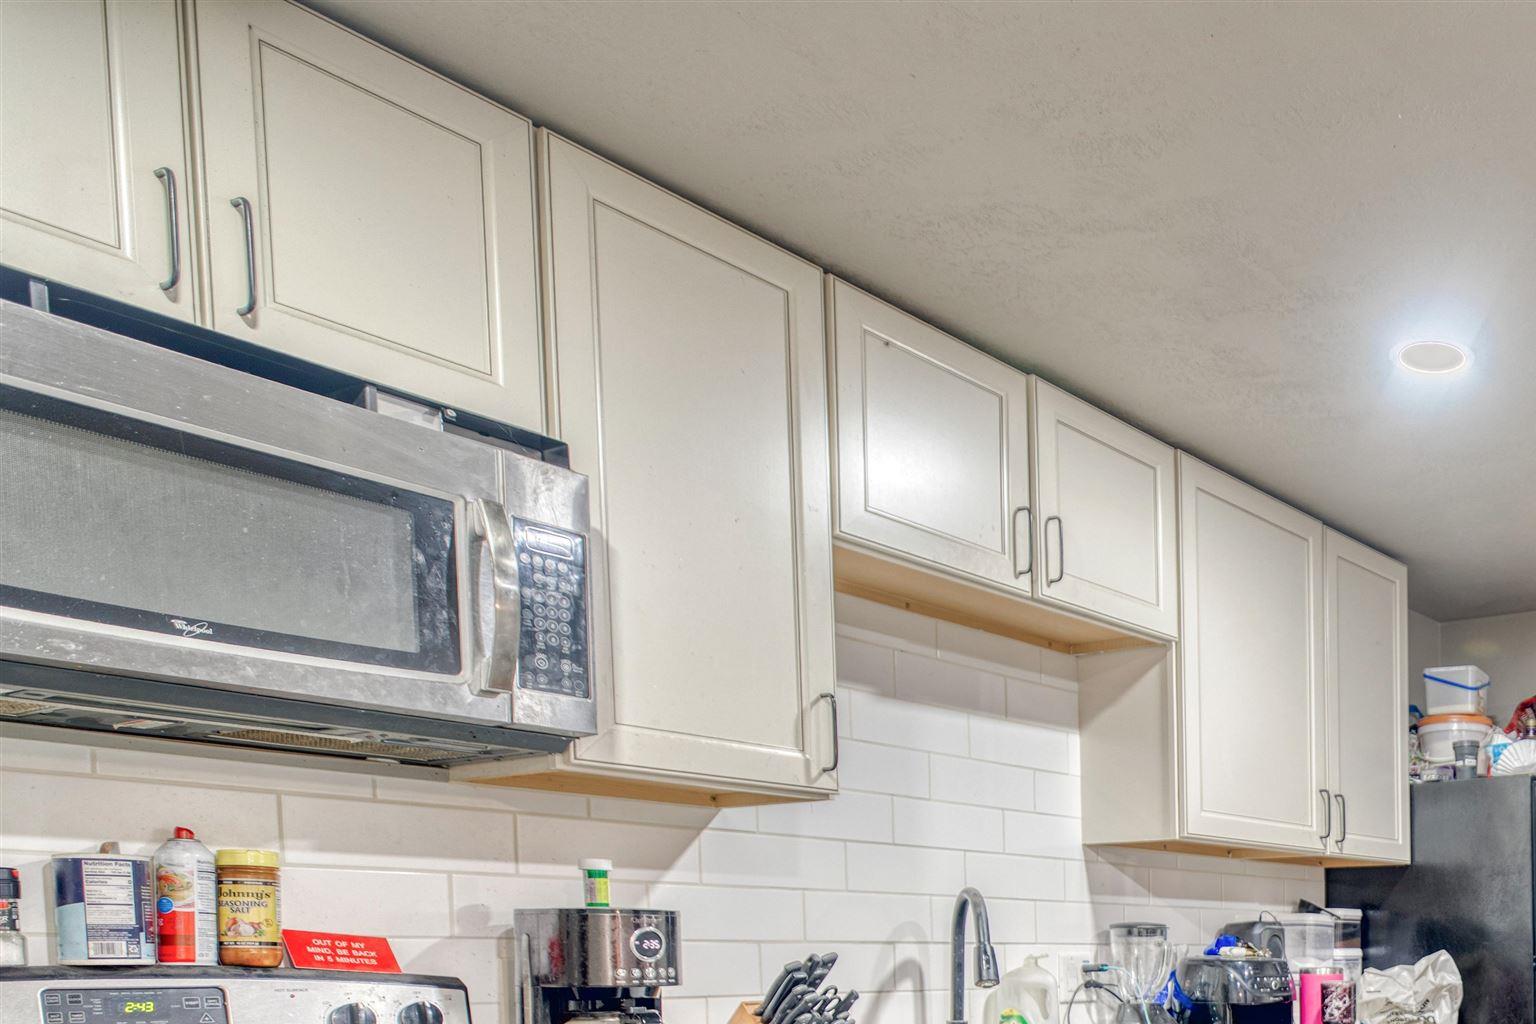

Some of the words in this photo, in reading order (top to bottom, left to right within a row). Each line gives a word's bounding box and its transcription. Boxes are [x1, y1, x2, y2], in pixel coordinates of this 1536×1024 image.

[173, 619, 213, 636] Whirlpool
[218, 887, 271, 900] Johnny's
[335, 940, 348, 948] OF
[351, 941, 365, 949] MY
[336, 948, 350, 956] BE
[336, 957, 378, 965] MINUTES
[124, 1001, 154, 1013] 2:43
